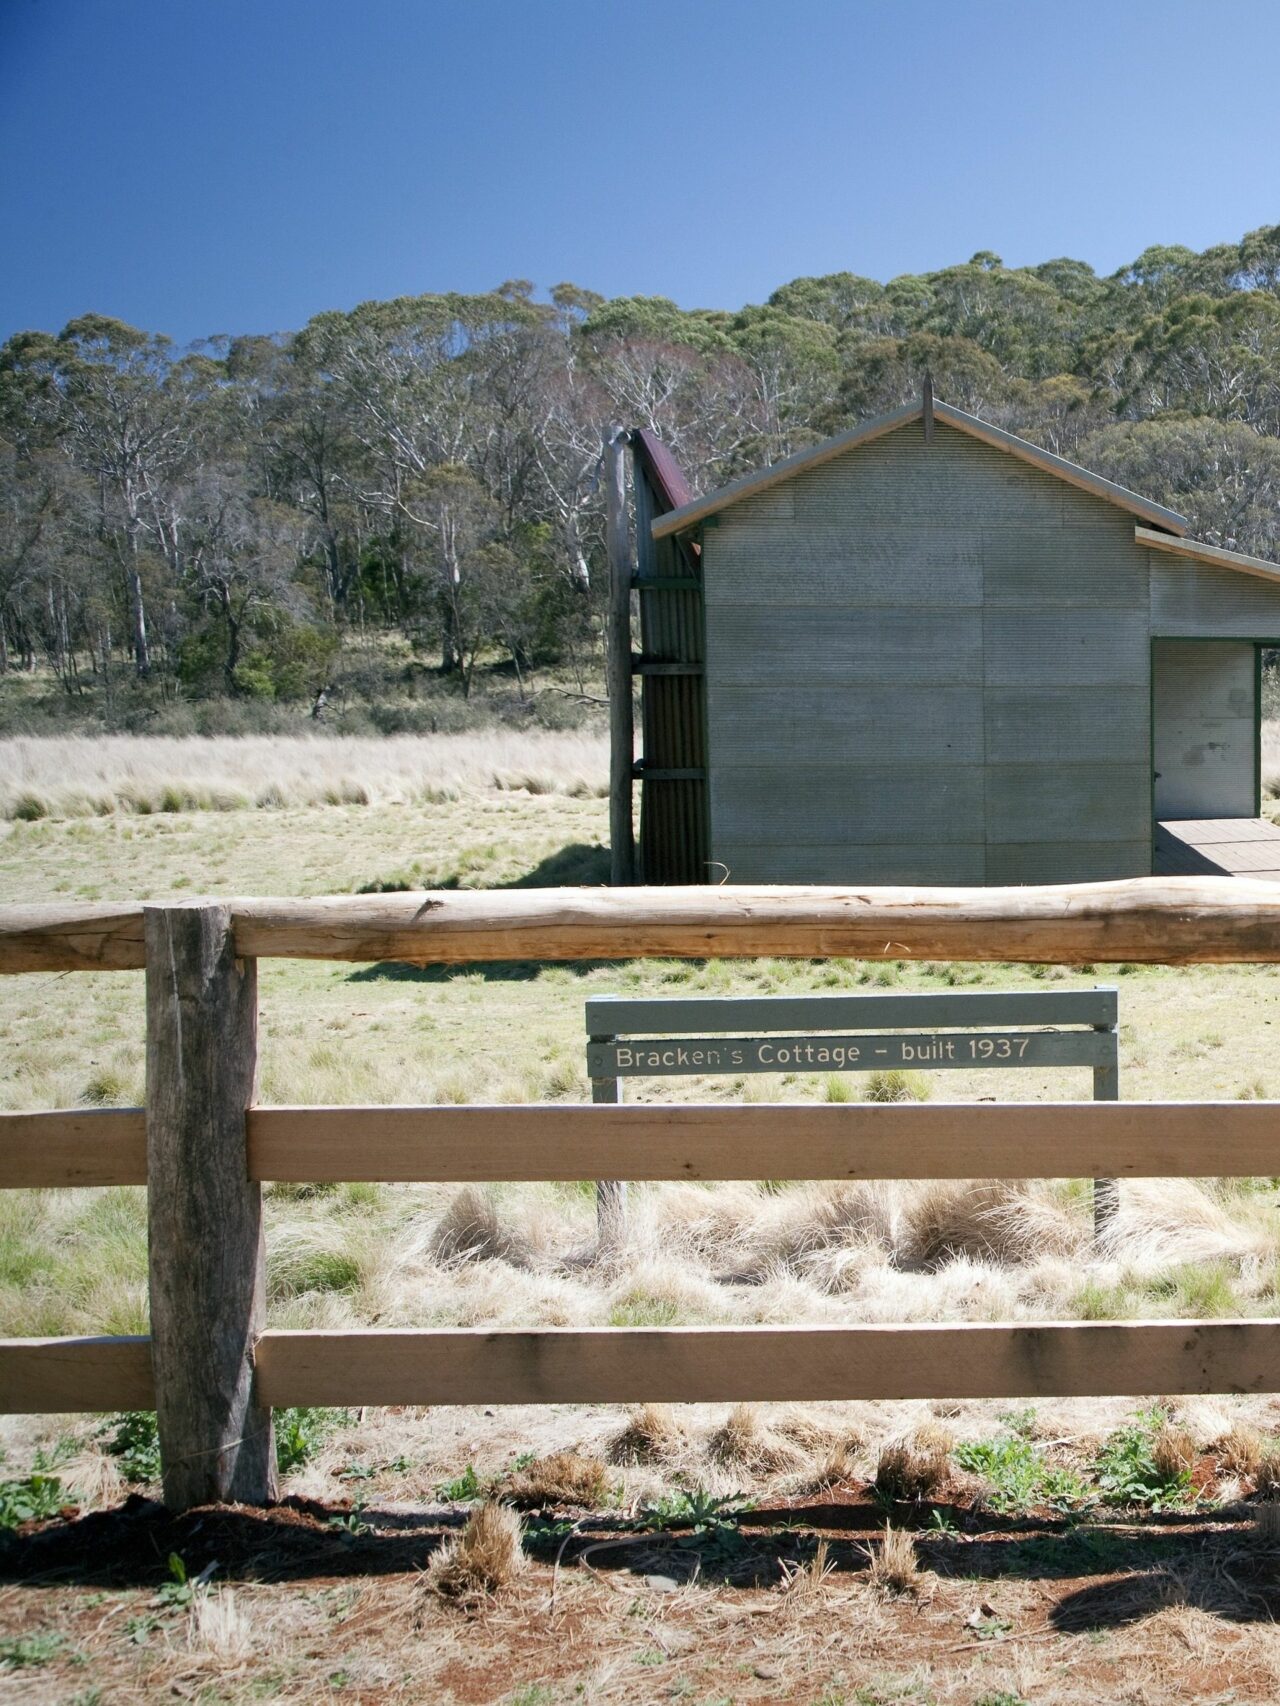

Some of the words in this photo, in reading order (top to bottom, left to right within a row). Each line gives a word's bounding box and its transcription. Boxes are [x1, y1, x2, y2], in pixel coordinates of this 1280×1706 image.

[616, 1047, 744, 1067] Bracken's
[758, 1044, 860, 1067] Cottage
[902, 1040, 955, 1060] built
[969, 1038, 1029, 1058] 1937
